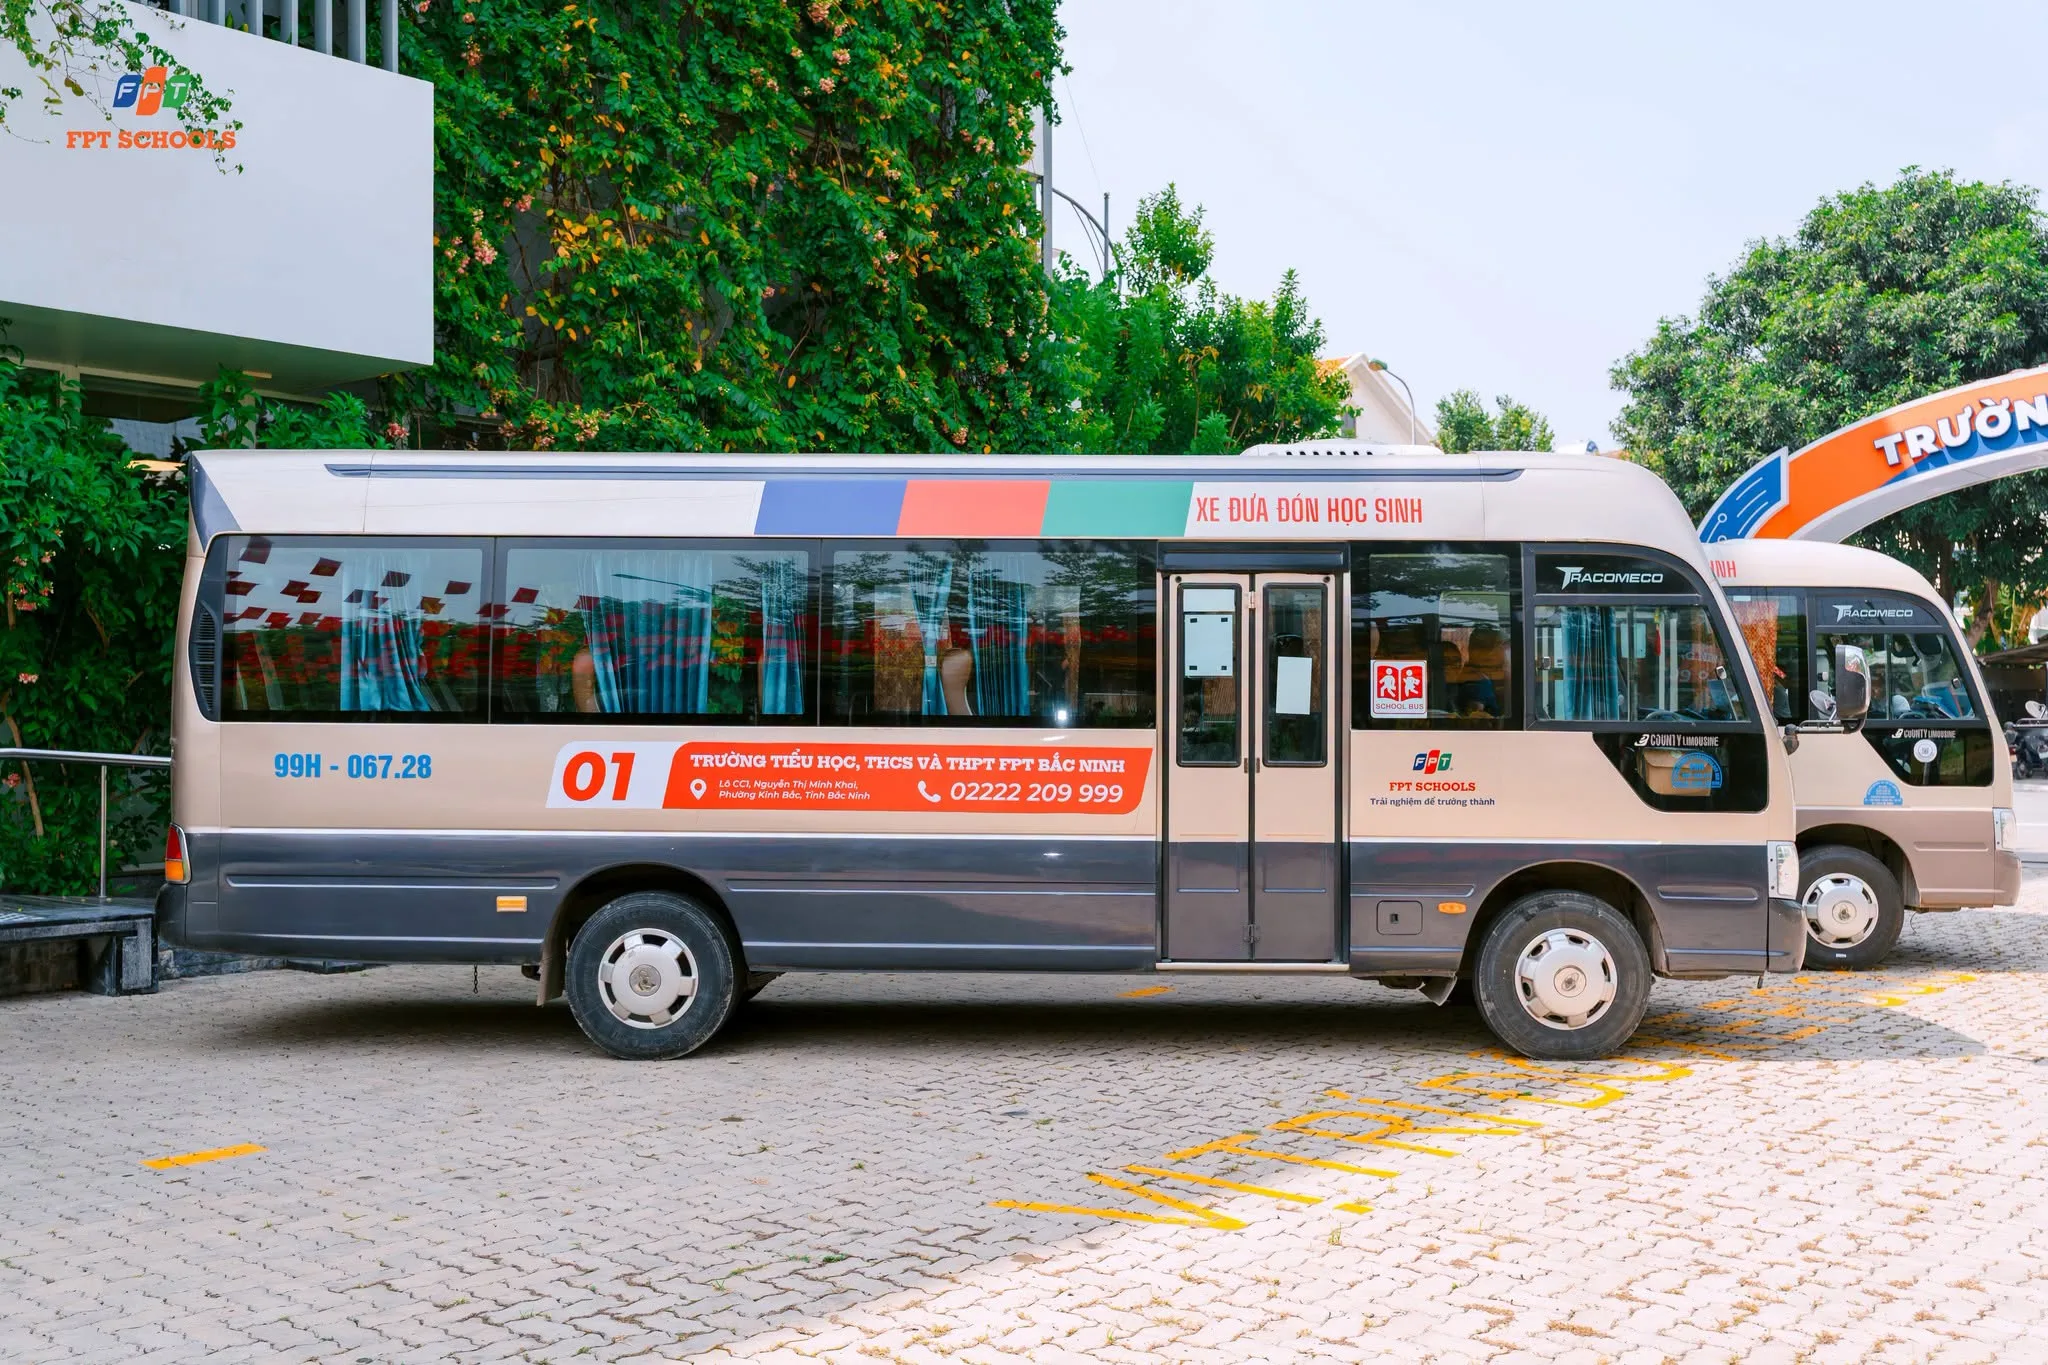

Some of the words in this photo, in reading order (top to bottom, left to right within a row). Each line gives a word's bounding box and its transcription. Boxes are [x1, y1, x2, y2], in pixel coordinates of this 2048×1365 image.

[66, 130, 111, 149] FPT
[117, 130, 237, 149] SCHOOLS
[1196, 497, 1219, 522] XE
[1228, 493, 1269, 523] ĐƯA
[1276, 493, 1319, 523] ĐÓN
[1327, 498, 1367, 526] HỌC
[1375, 498, 1423, 523] SINH
[1555, 566, 1664, 590] TRACOMECO
[1832, 604, 1914, 622] TRACOMECO
[1650, 734, 1682, 747] COUNTY
[1682, 736, 1719, 747] LIMOUSINE
[1903, 729, 1928, 738] COUNTY
[274, 753, 321, 778] 99H
[347, 754, 432, 779] 067.28
[690, 751, 767, 769] TRƯỜNG
[770, 748, 813, 769] TIỂU
[817, 755, 861, 772] HỌC,
[865, 756, 913, 770] THCS
[917, 753, 941, 770] VÀ
[946, 757, 995, 772] THPT
[999, 759, 1035, 772] FPT
[1038, 751, 1076, 773] BẮC
[1079, 759, 1126, 773] NINH
[562, 751, 636, 802] 01
[719, 779, 731, 788] Lô
[753, 779, 791, 790] Nguyễn
[793, 780, 807, 790] Thị
[809, 780, 833, 789] Minh
[834, 780, 859, 790] Khai,
[719, 790, 756, 800] Phường
[758, 790, 780, 799] Kinh
[805, 790, 825, 799] Tỉnh
[828, 790, 846, 800] Bắc
[848, 791, 871, 800] Ninh
[950, 782, 1021, 801] 02222
[1026, 782, 1073, 802] 209
[1078, 783, 1124, 803] 999
[1389, 782, 1412, 791] FPT
[1415, 782, 1476, 791] SCHOOLS
[1370, 798, 1387, 806] Trải
[1390, 797, 1422, 807] nghiệm
[1424, 796, 1435, 806] để
[1437, 797, 1467, 807] trưởng
[1469, 797, 1495, 806] thành
